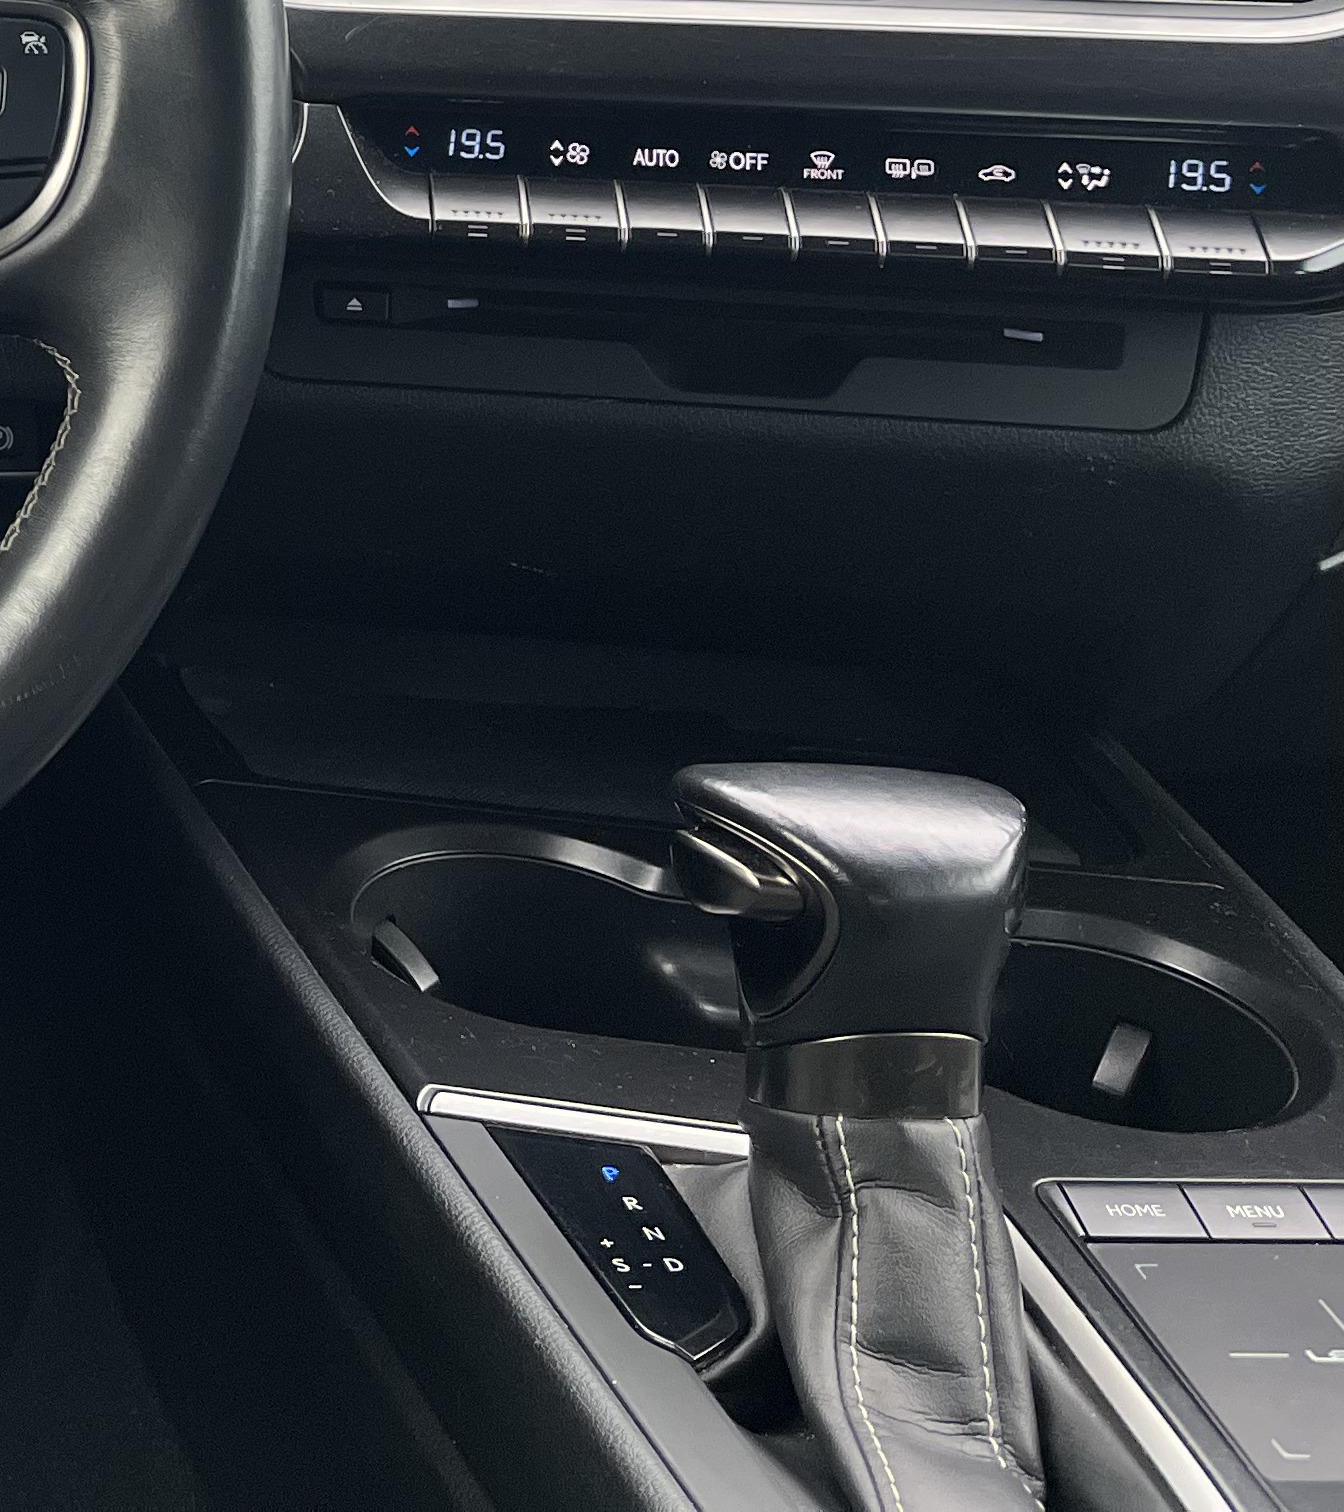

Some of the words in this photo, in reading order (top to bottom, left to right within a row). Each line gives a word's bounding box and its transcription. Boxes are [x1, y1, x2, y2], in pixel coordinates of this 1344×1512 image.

[448, 128, 505, 161] 19.5
[632, 148, 680, 168] AUTO
[728, 152, 770, 172] OFF
[803, 168, 844, 181] FRONT
[1169, 159, 1233, 193] 19.5
[600, 1164, 620, 1184] P
[622, 1196, 643, 1211] R
[1105, 1203, 1167, 1218] HOME
[1225, 1203, 1286, 1220] MENU
[641, 1226, 666, 1241] N
[611, 1257, 631, 1273] S
[662, 1257, 684, 1273] D
